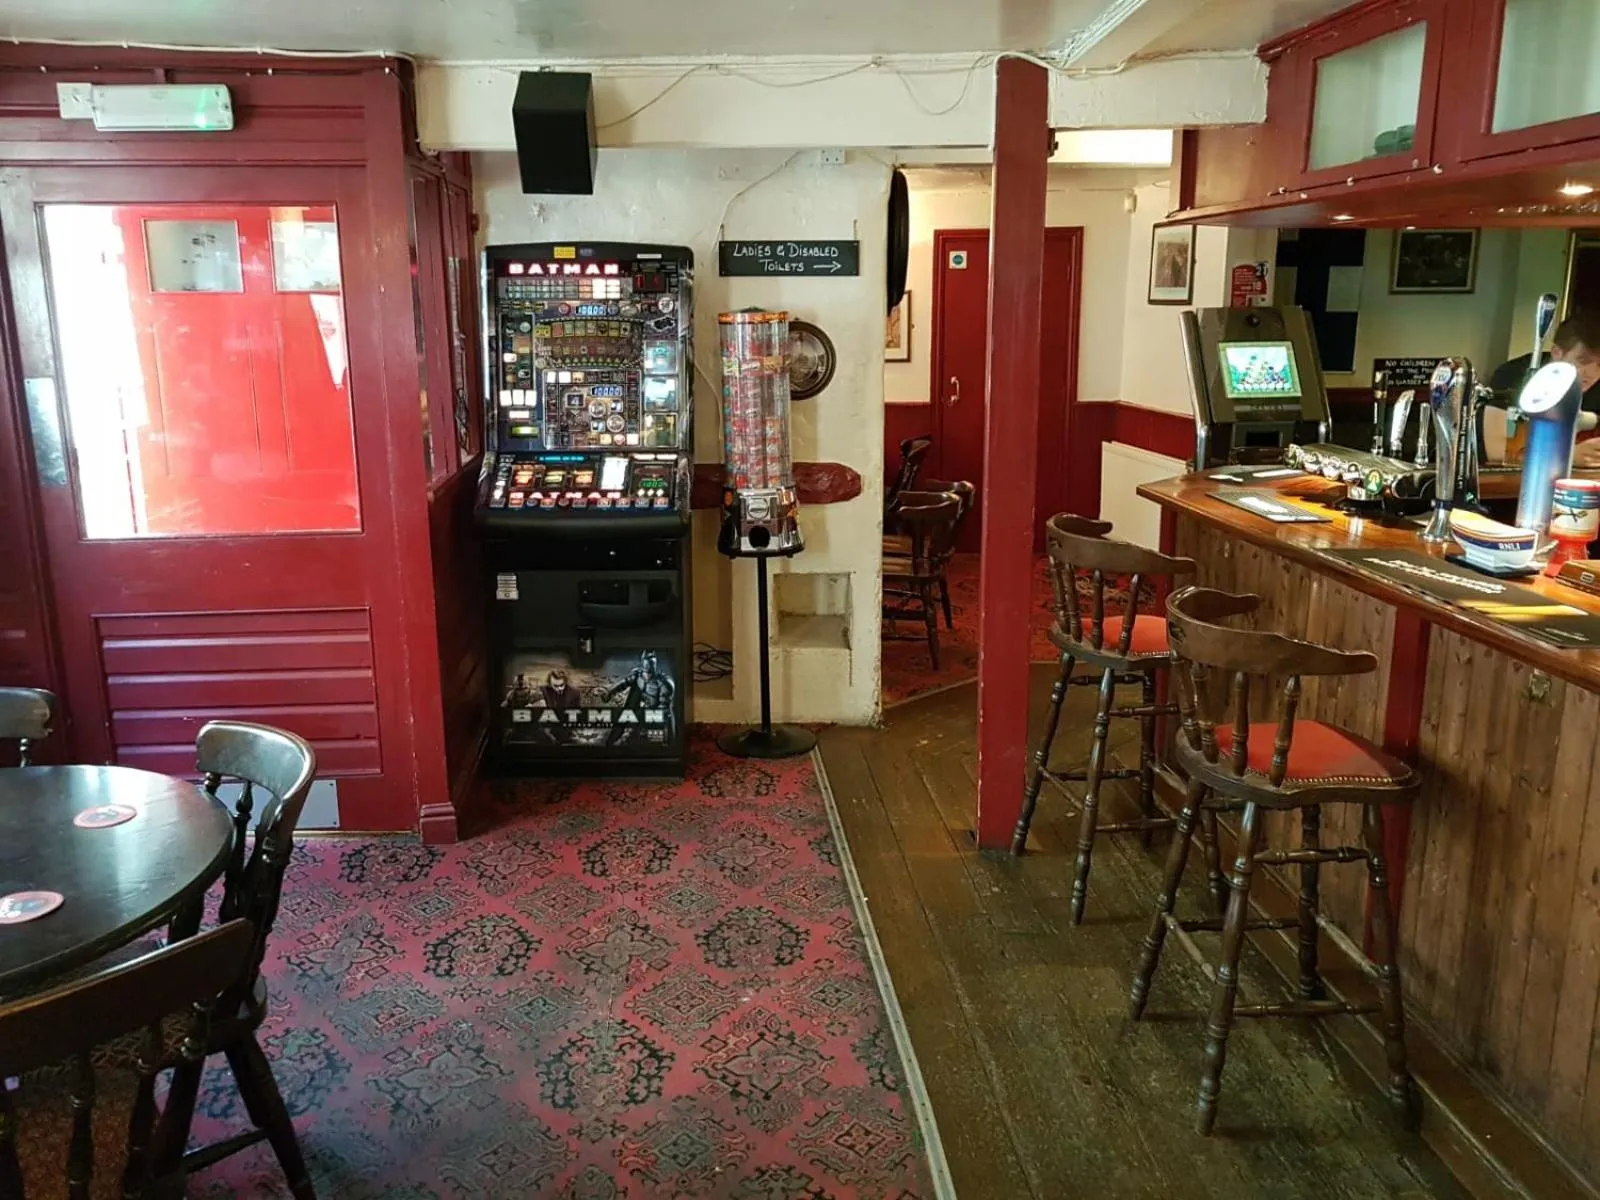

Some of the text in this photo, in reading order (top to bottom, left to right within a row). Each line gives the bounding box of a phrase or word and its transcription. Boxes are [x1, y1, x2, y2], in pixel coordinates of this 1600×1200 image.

[733, 243, 839, 257] LADIES & DISABLED
[509, 262, 619, 275] BATMAN
[758, 259, 805, 272] TOILETS
[1498, 542, 1521, 551] RNLI
[512, 709, 665, 723] BATMAN
